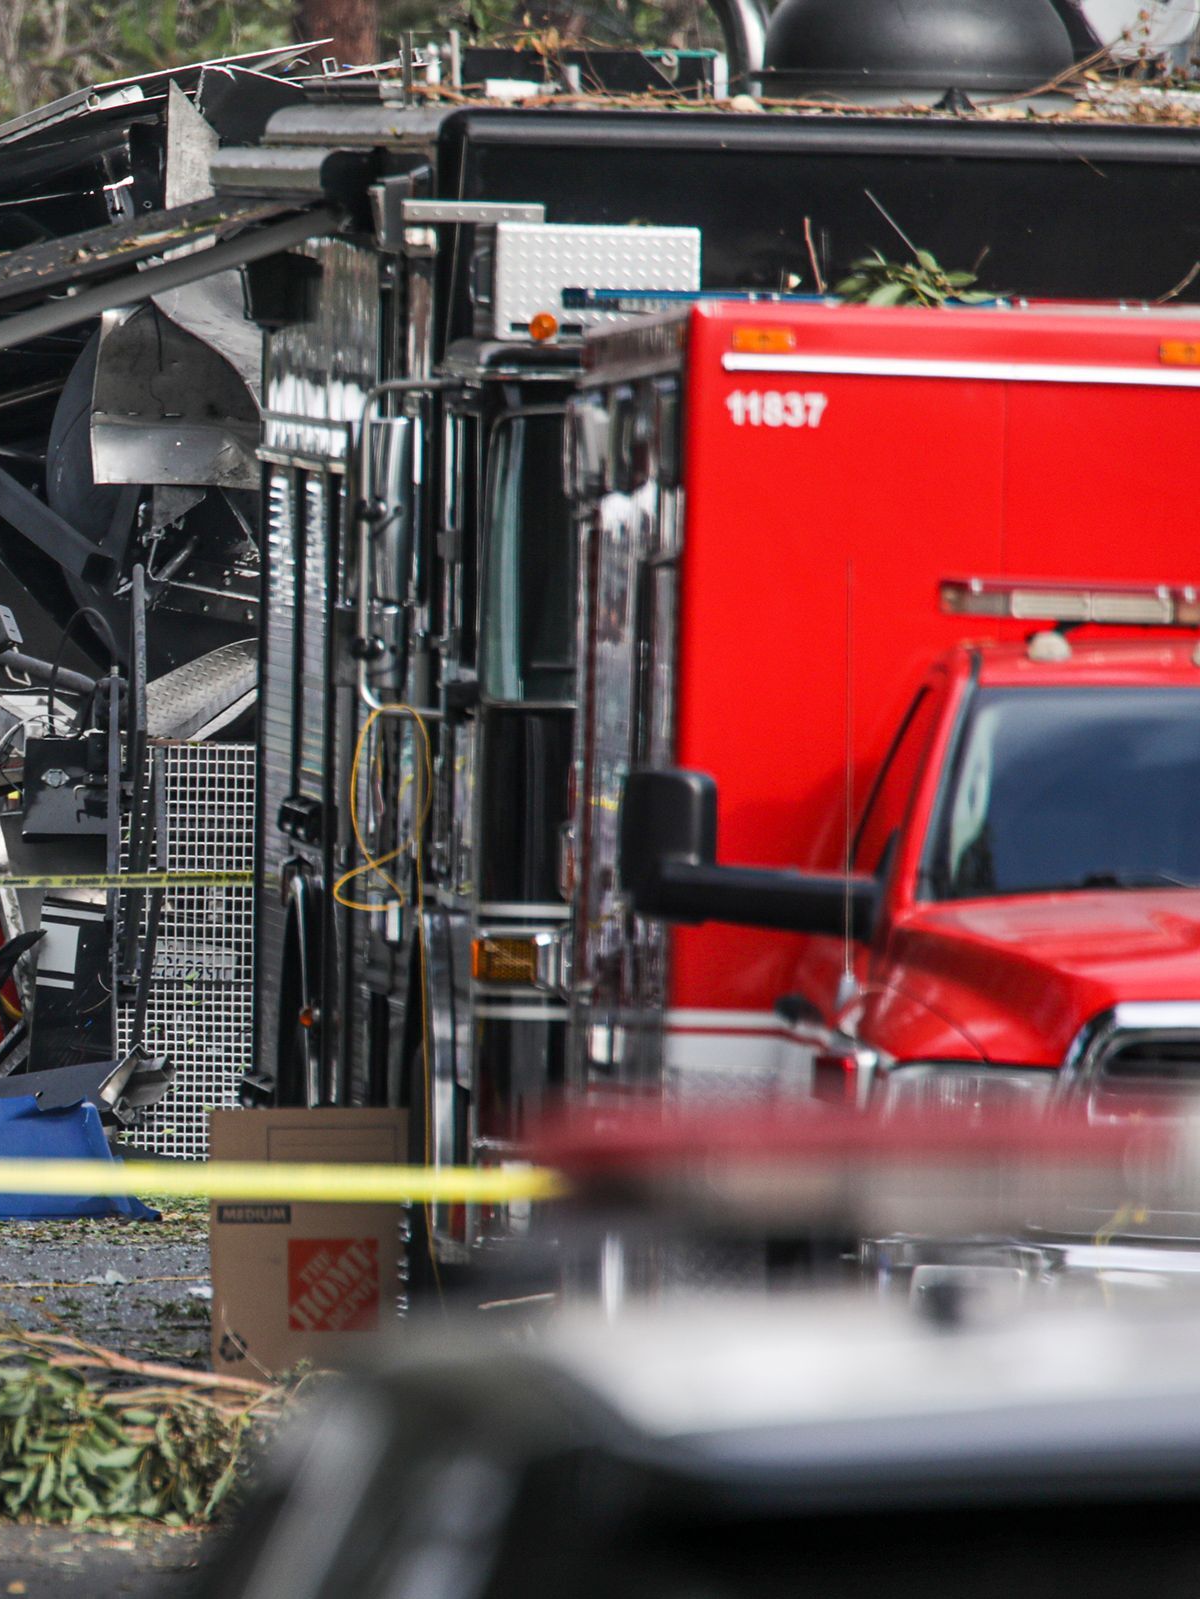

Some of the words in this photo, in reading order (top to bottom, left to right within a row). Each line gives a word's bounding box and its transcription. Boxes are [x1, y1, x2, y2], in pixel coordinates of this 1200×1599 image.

[725, 389, 828, 428] 11837
[222, 1206, 286, 1220] MEDIUM
[300, 1247, 332, 1283] THE
[290, 1237, 377, 1331] HOME
